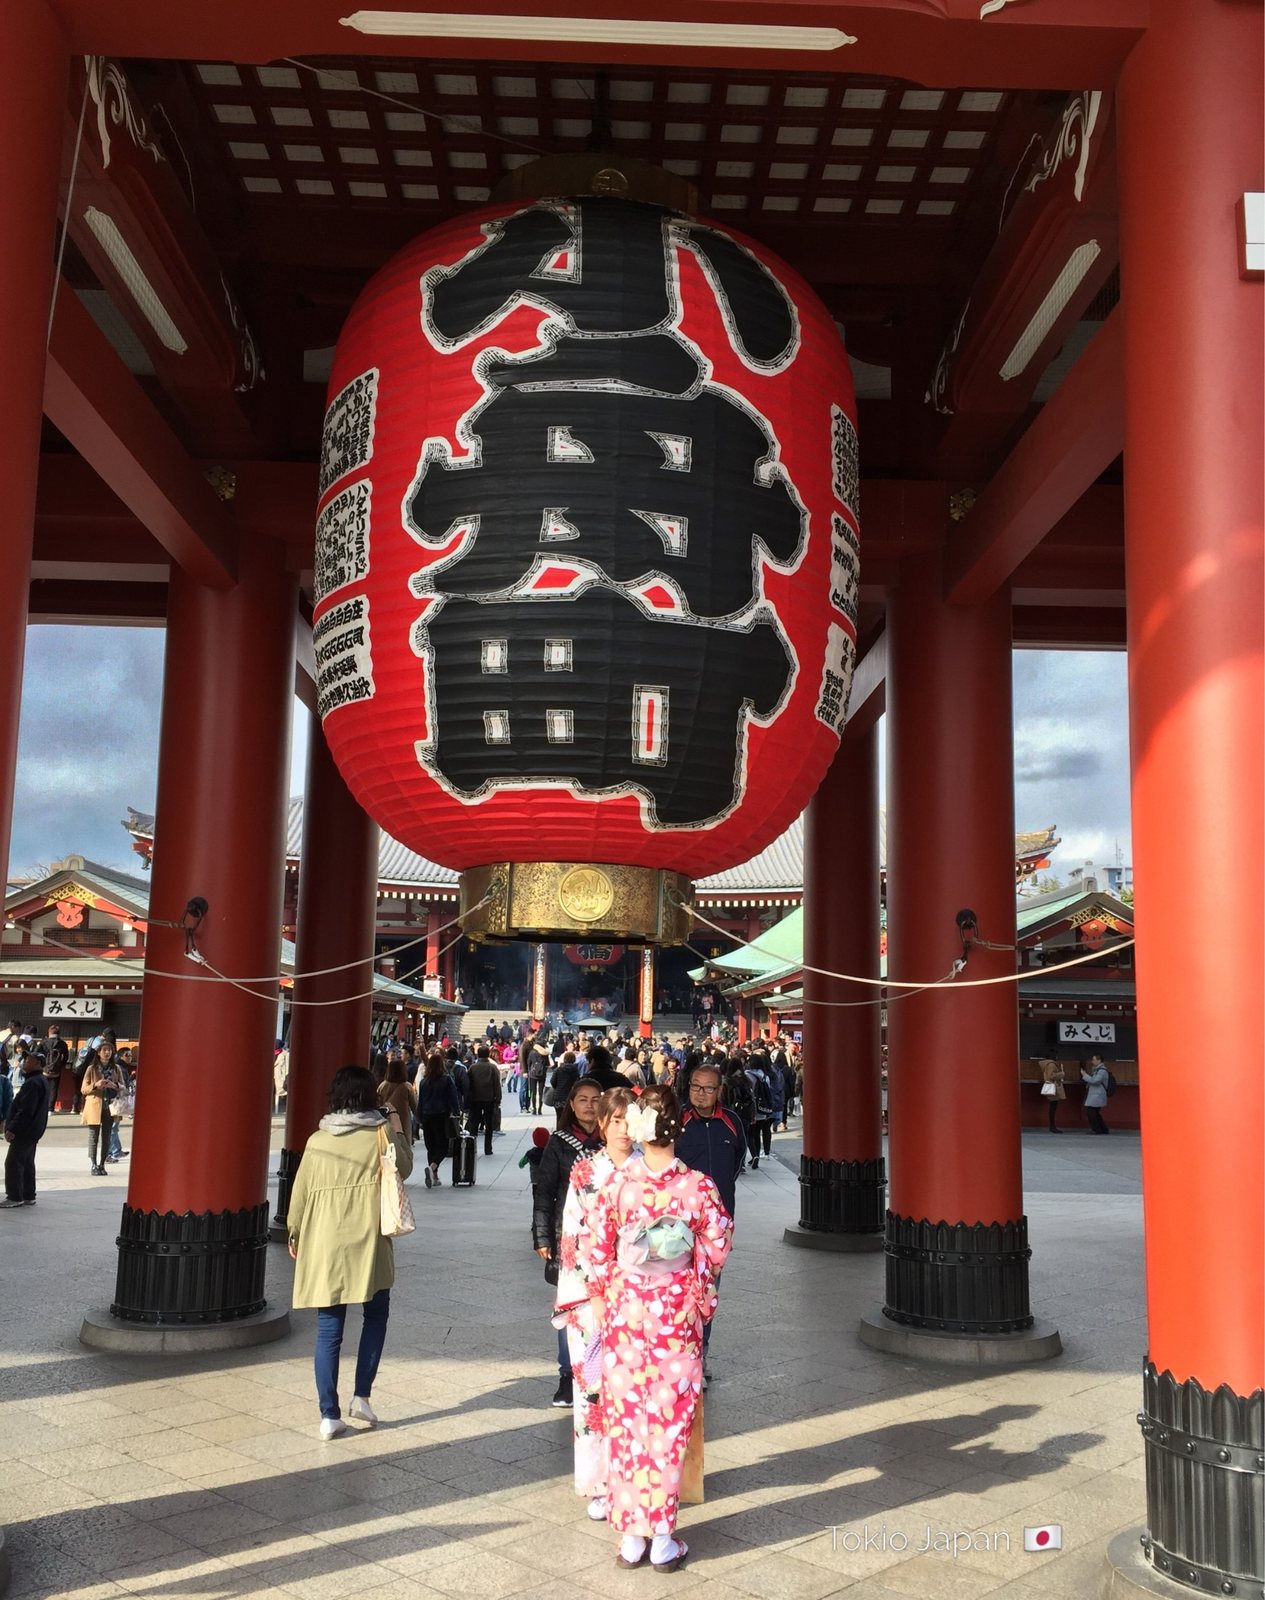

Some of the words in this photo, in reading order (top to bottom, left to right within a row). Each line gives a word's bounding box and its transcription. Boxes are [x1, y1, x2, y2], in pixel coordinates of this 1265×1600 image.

[355, 484, 369, 578] ハタヤリミテッド
[49, 1000, 97, 1015] みくじ
[1065, 1024, 1110, 1038] みくじ
